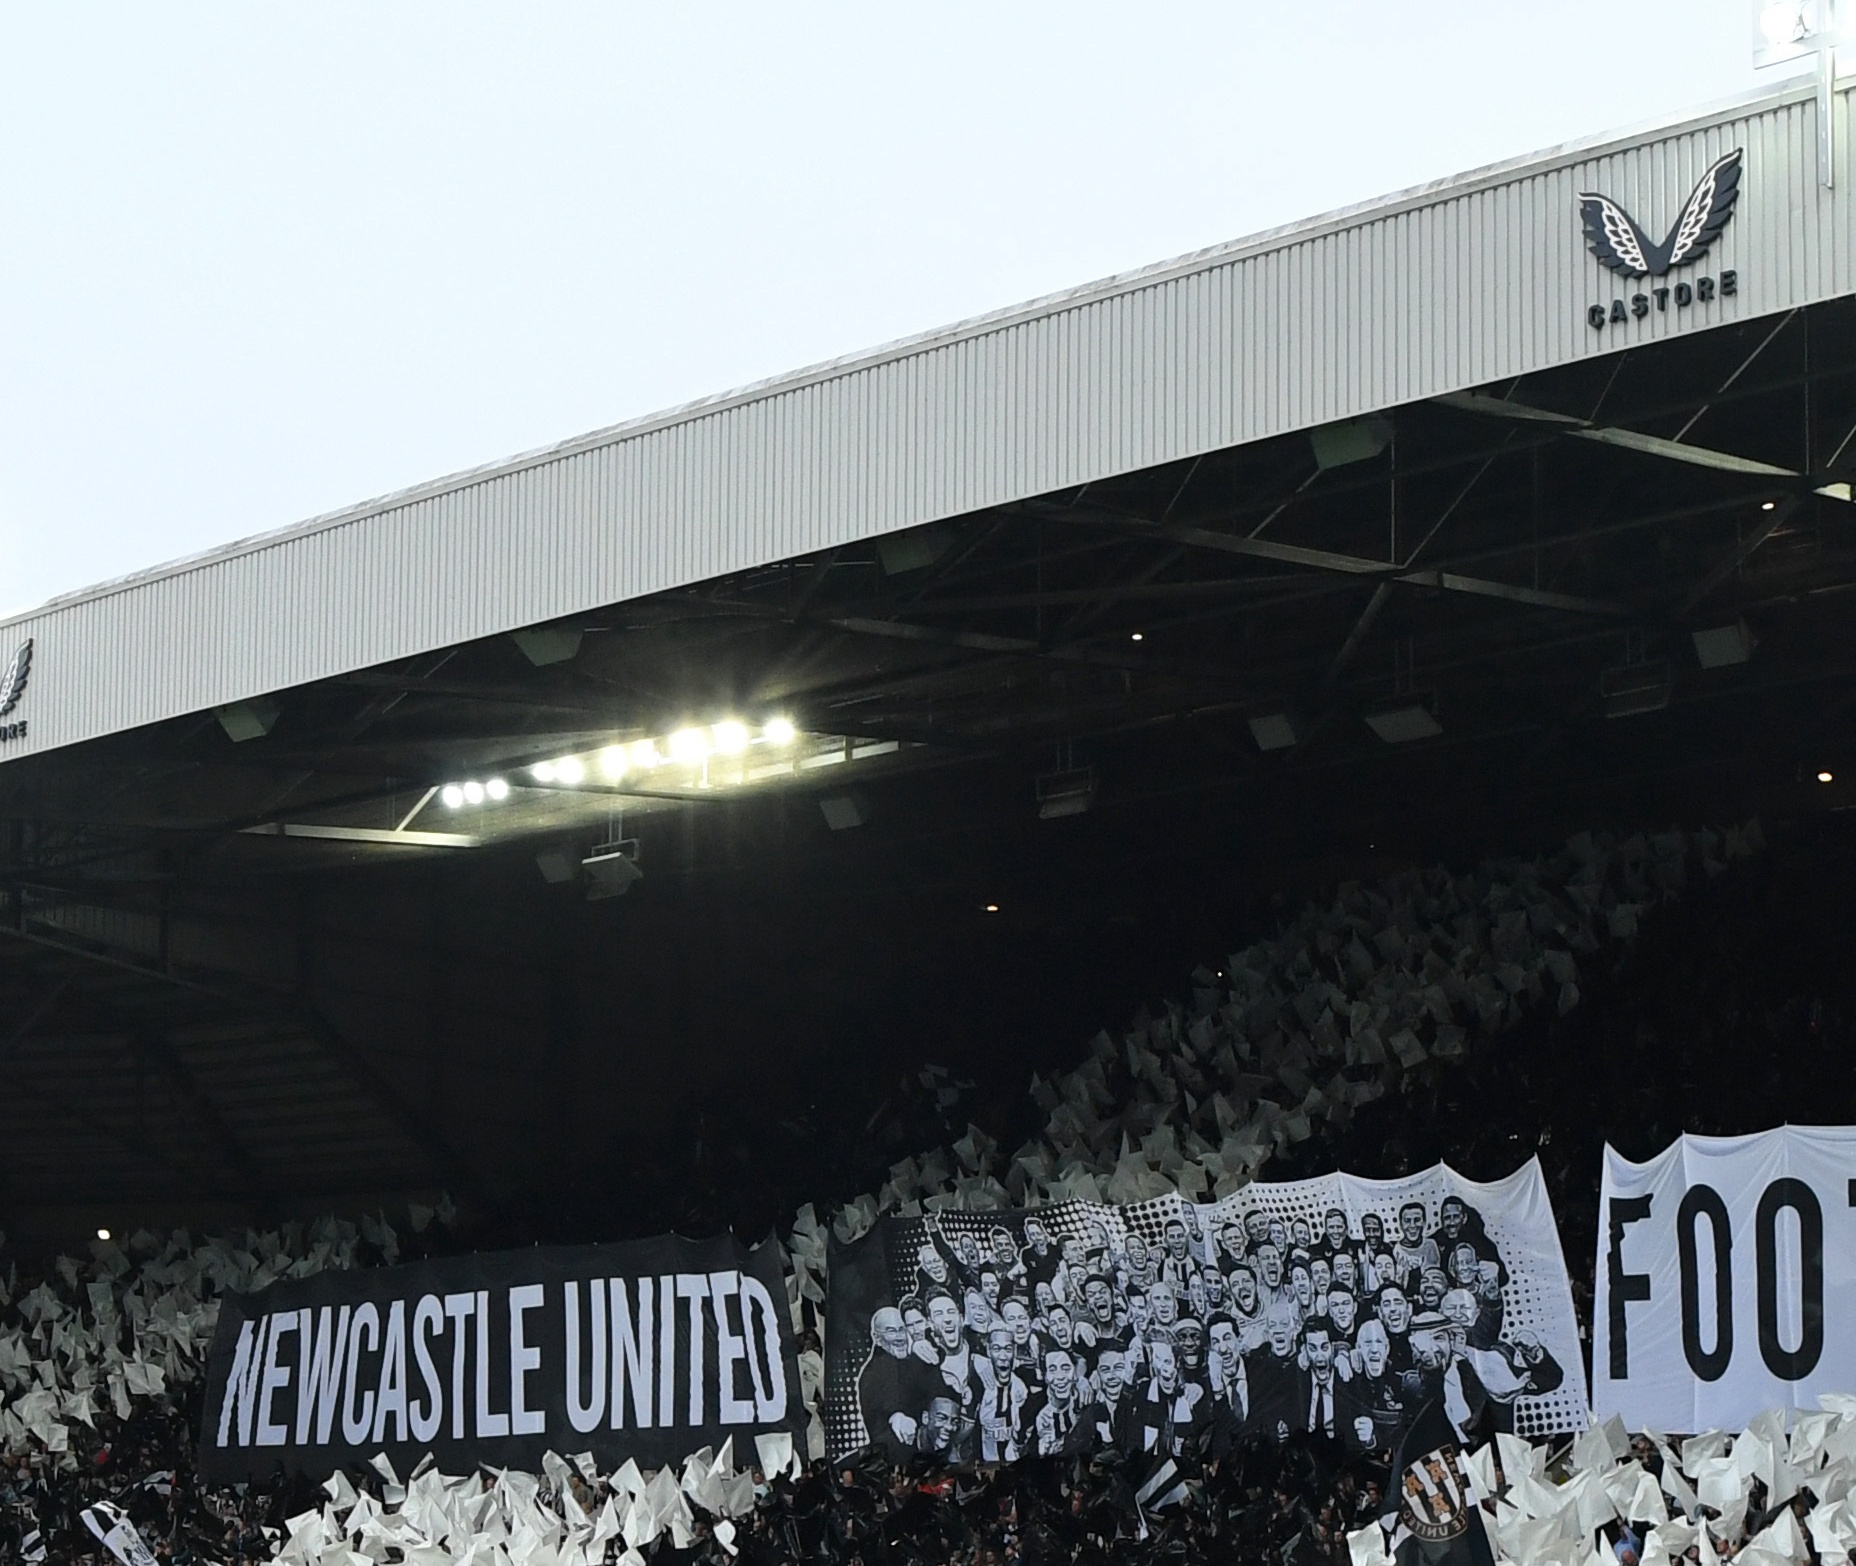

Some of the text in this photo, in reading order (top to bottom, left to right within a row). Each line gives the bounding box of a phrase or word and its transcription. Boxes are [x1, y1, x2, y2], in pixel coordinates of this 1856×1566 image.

[1587, 270, 1738, 331] CASTORE
[216, 1269, 788, 1448] NEWCASTLE UNITED
